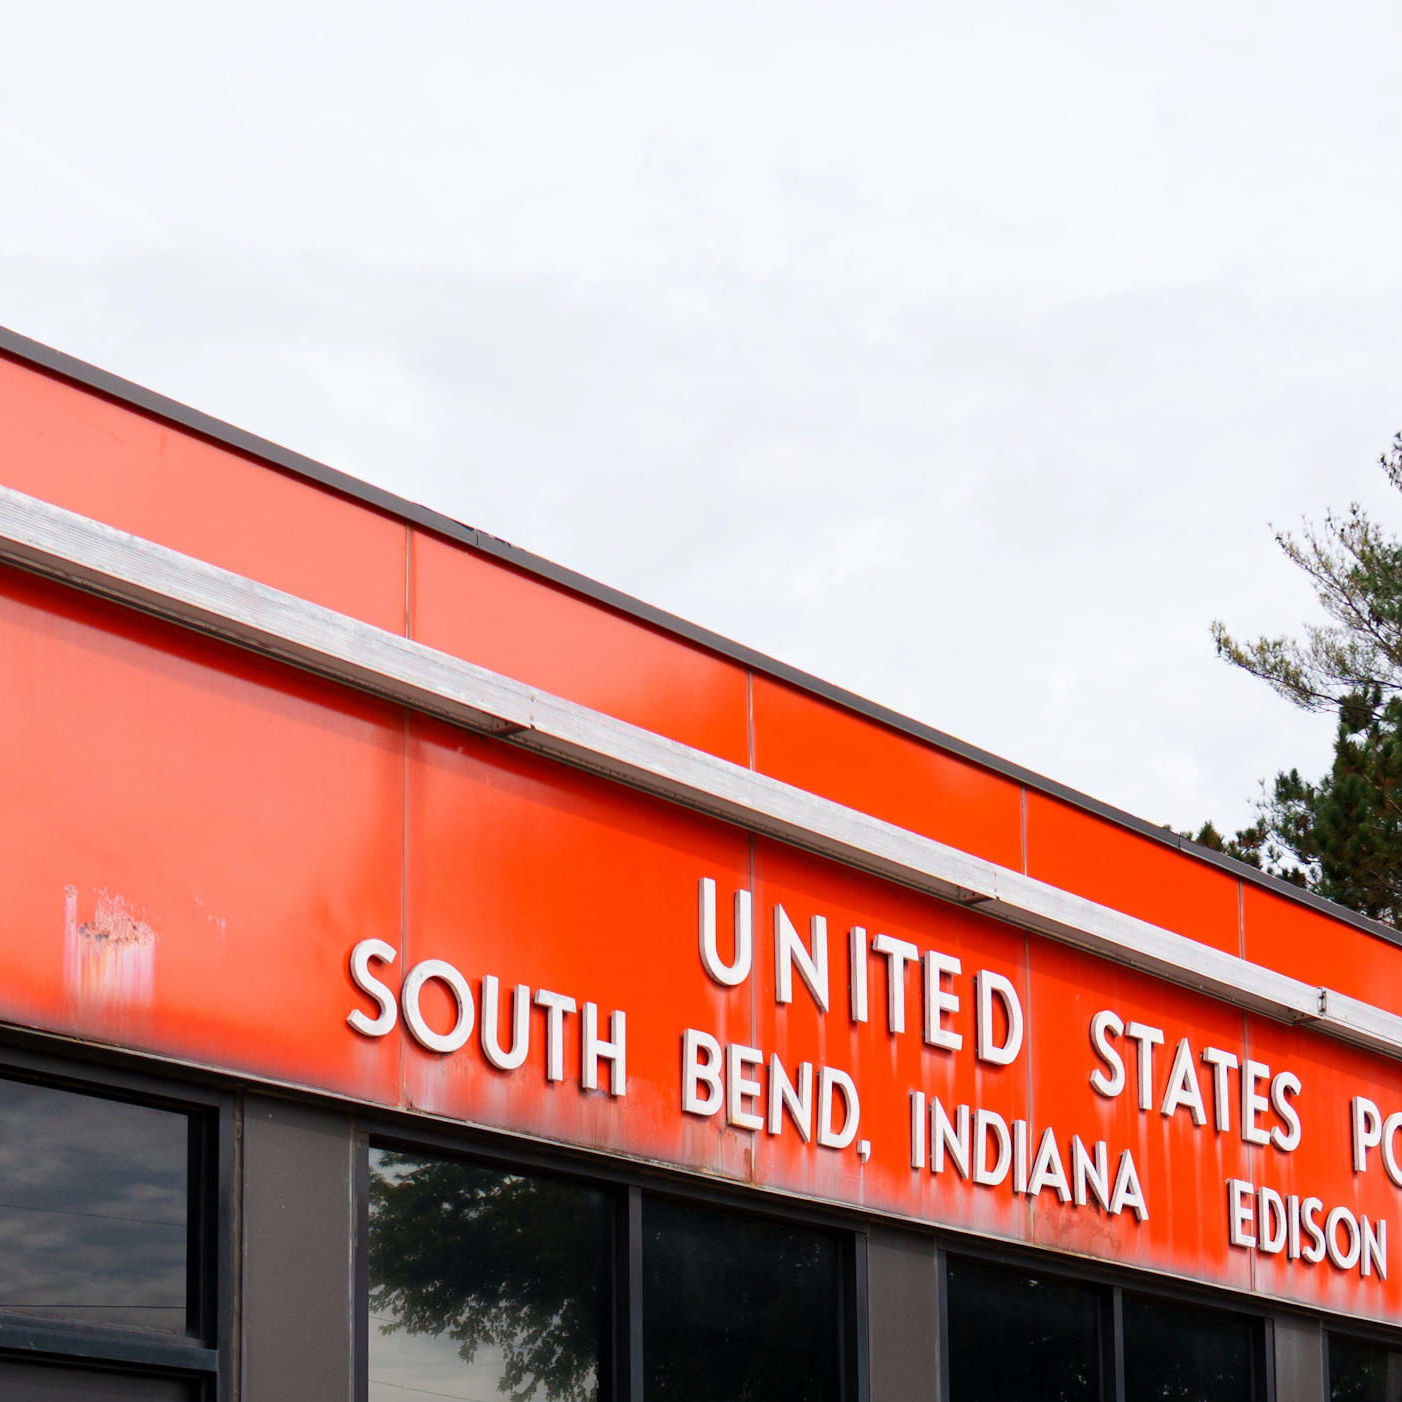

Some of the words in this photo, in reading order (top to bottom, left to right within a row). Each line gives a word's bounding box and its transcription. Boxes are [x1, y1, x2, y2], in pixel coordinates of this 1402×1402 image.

[346, 938, 627, 1097] SOUTH
[681, 1027, 871, 1164] BEND,
[910, 1090, 1150, 1222] INDIANA
[1227, 1178, 1387, 1281] EDISON
[698, 877, 1024, 1067] UNITED
[1089, 1010, 1302, 1153] STATES
